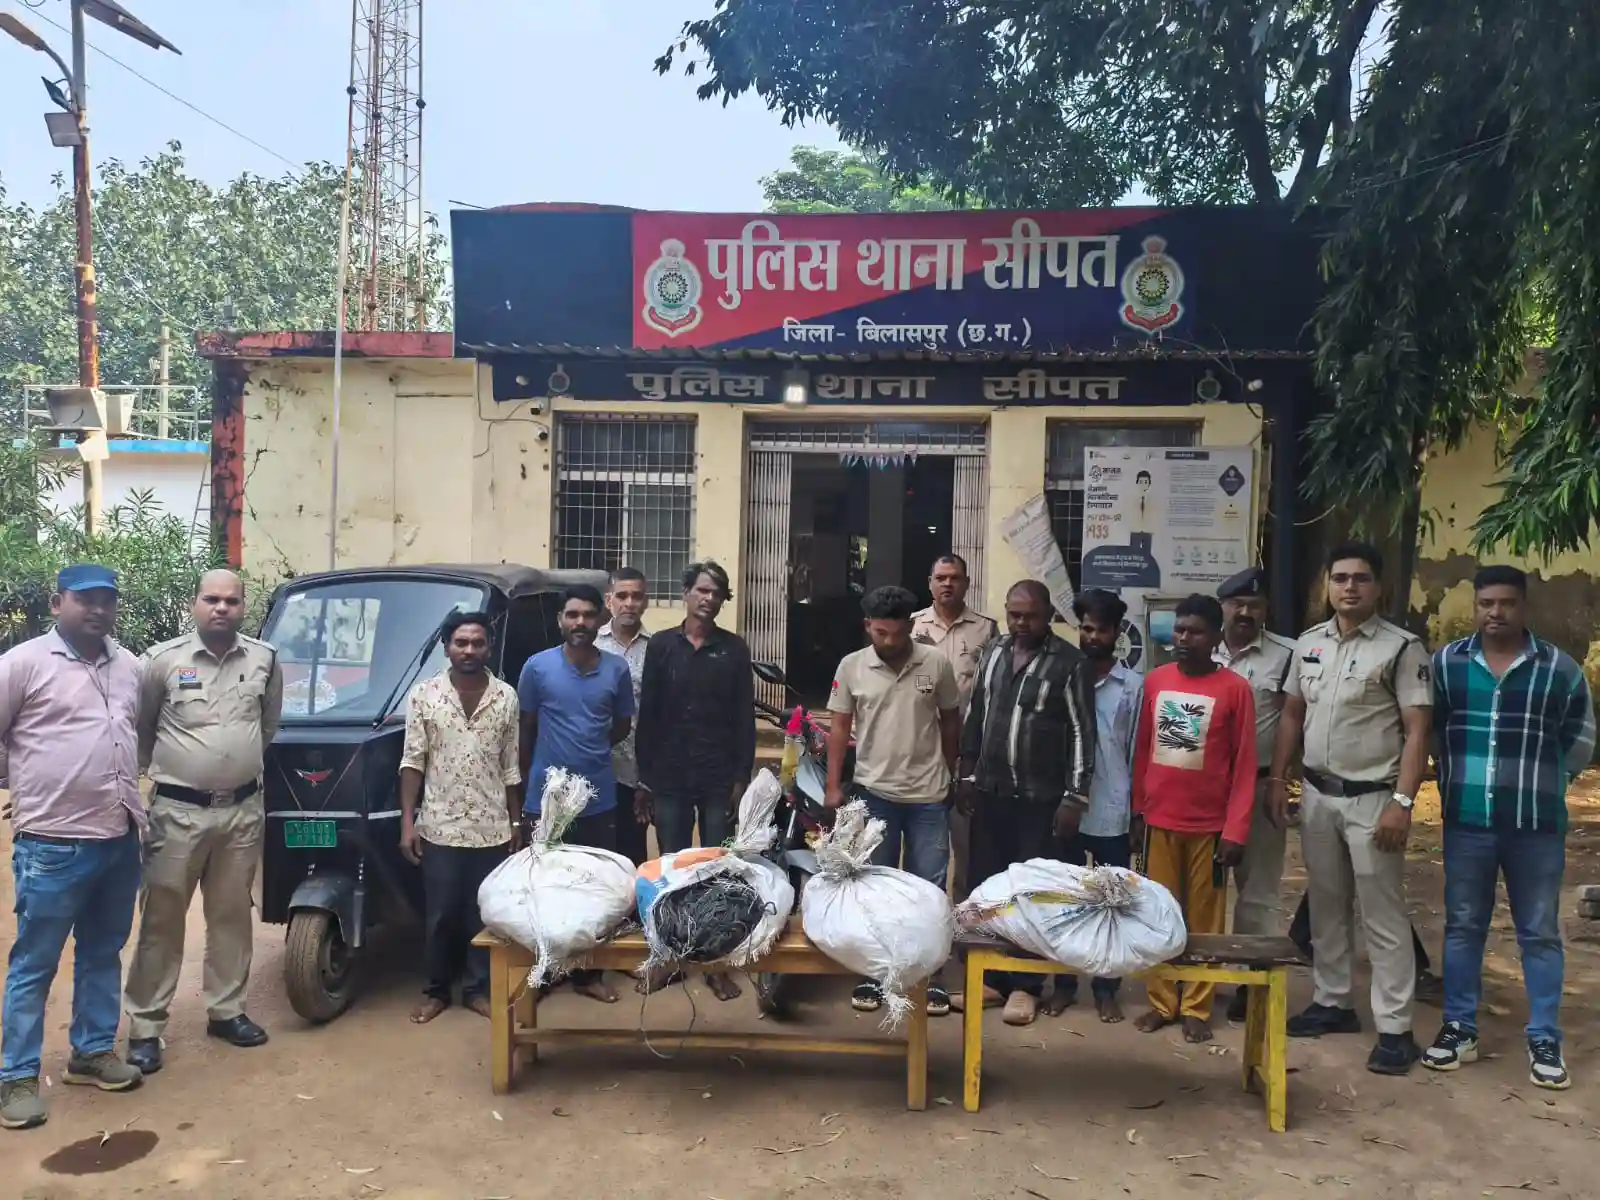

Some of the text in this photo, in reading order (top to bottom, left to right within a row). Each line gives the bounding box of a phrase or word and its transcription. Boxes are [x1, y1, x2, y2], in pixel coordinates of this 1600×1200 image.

[704, 217, 1121, 311] पुलिस थाना सीपत
[857, 316, 948, 350] बिलासपुर
[957, 317, 1032, 348] (छ.ग.)
[627, 369, 1127, 400] पुलिस थाना सीपत
